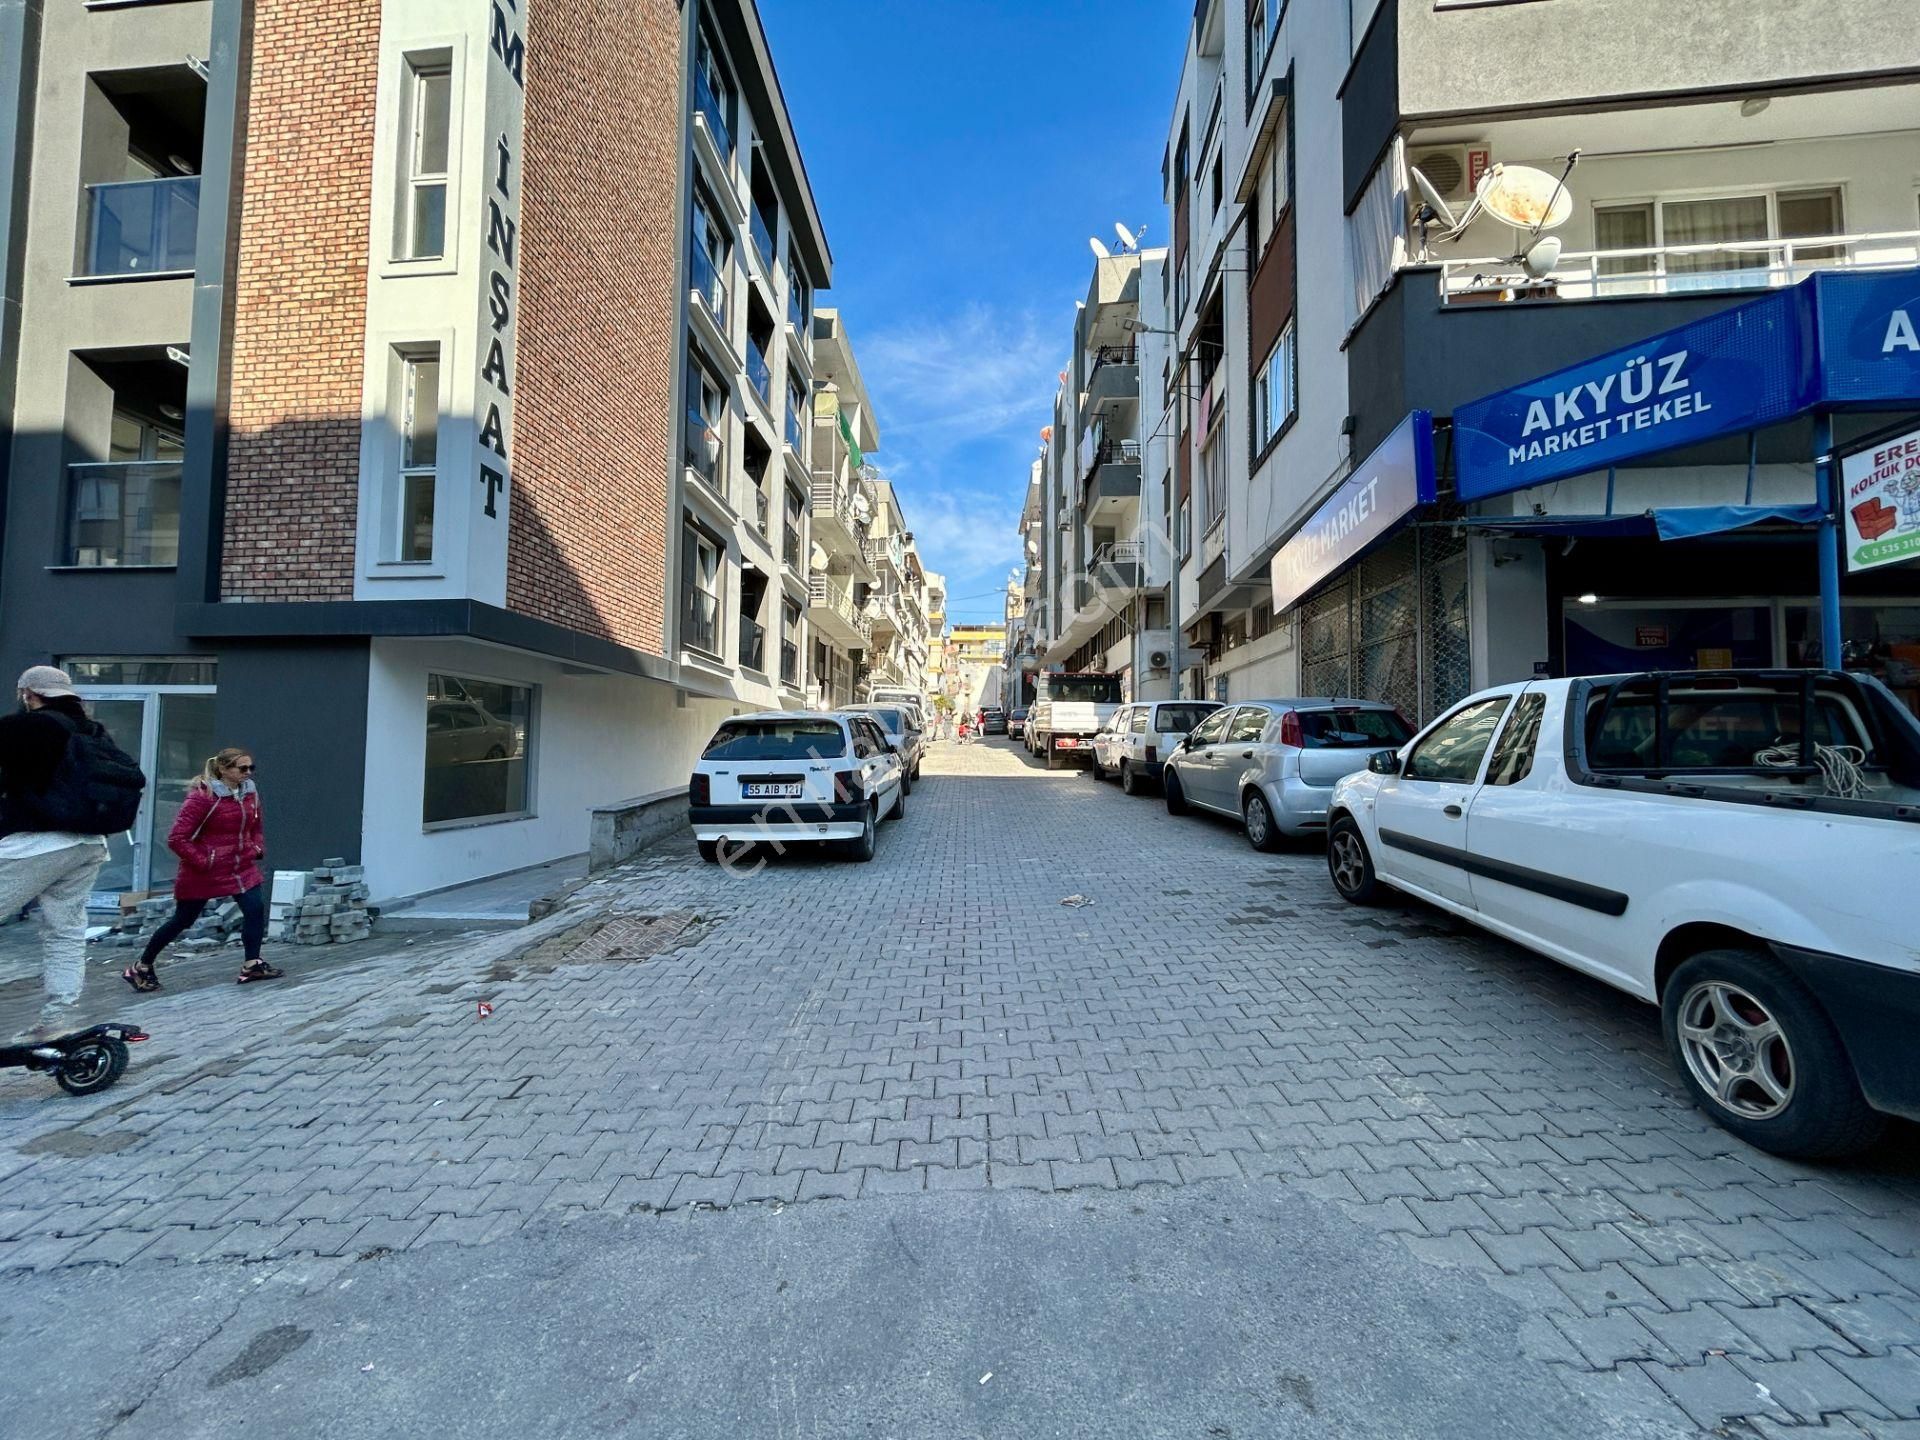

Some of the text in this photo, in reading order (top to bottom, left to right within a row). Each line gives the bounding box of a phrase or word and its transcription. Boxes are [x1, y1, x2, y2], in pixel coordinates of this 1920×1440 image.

[479, 0, 525, 519] M İNŞAAT
[1509, 391, 1712, 465] MARKET TEKEL
[1522, 350, 1689, 437] AKYÜZ
[1320, 476, 1378, 556] MARKET
[1850, 461, 1900, 498] KOLTUK
[1881, 543, 1900, 555] 535
[749, 785, 761, 794] 55
[764, 785, 780, 794] AIB
